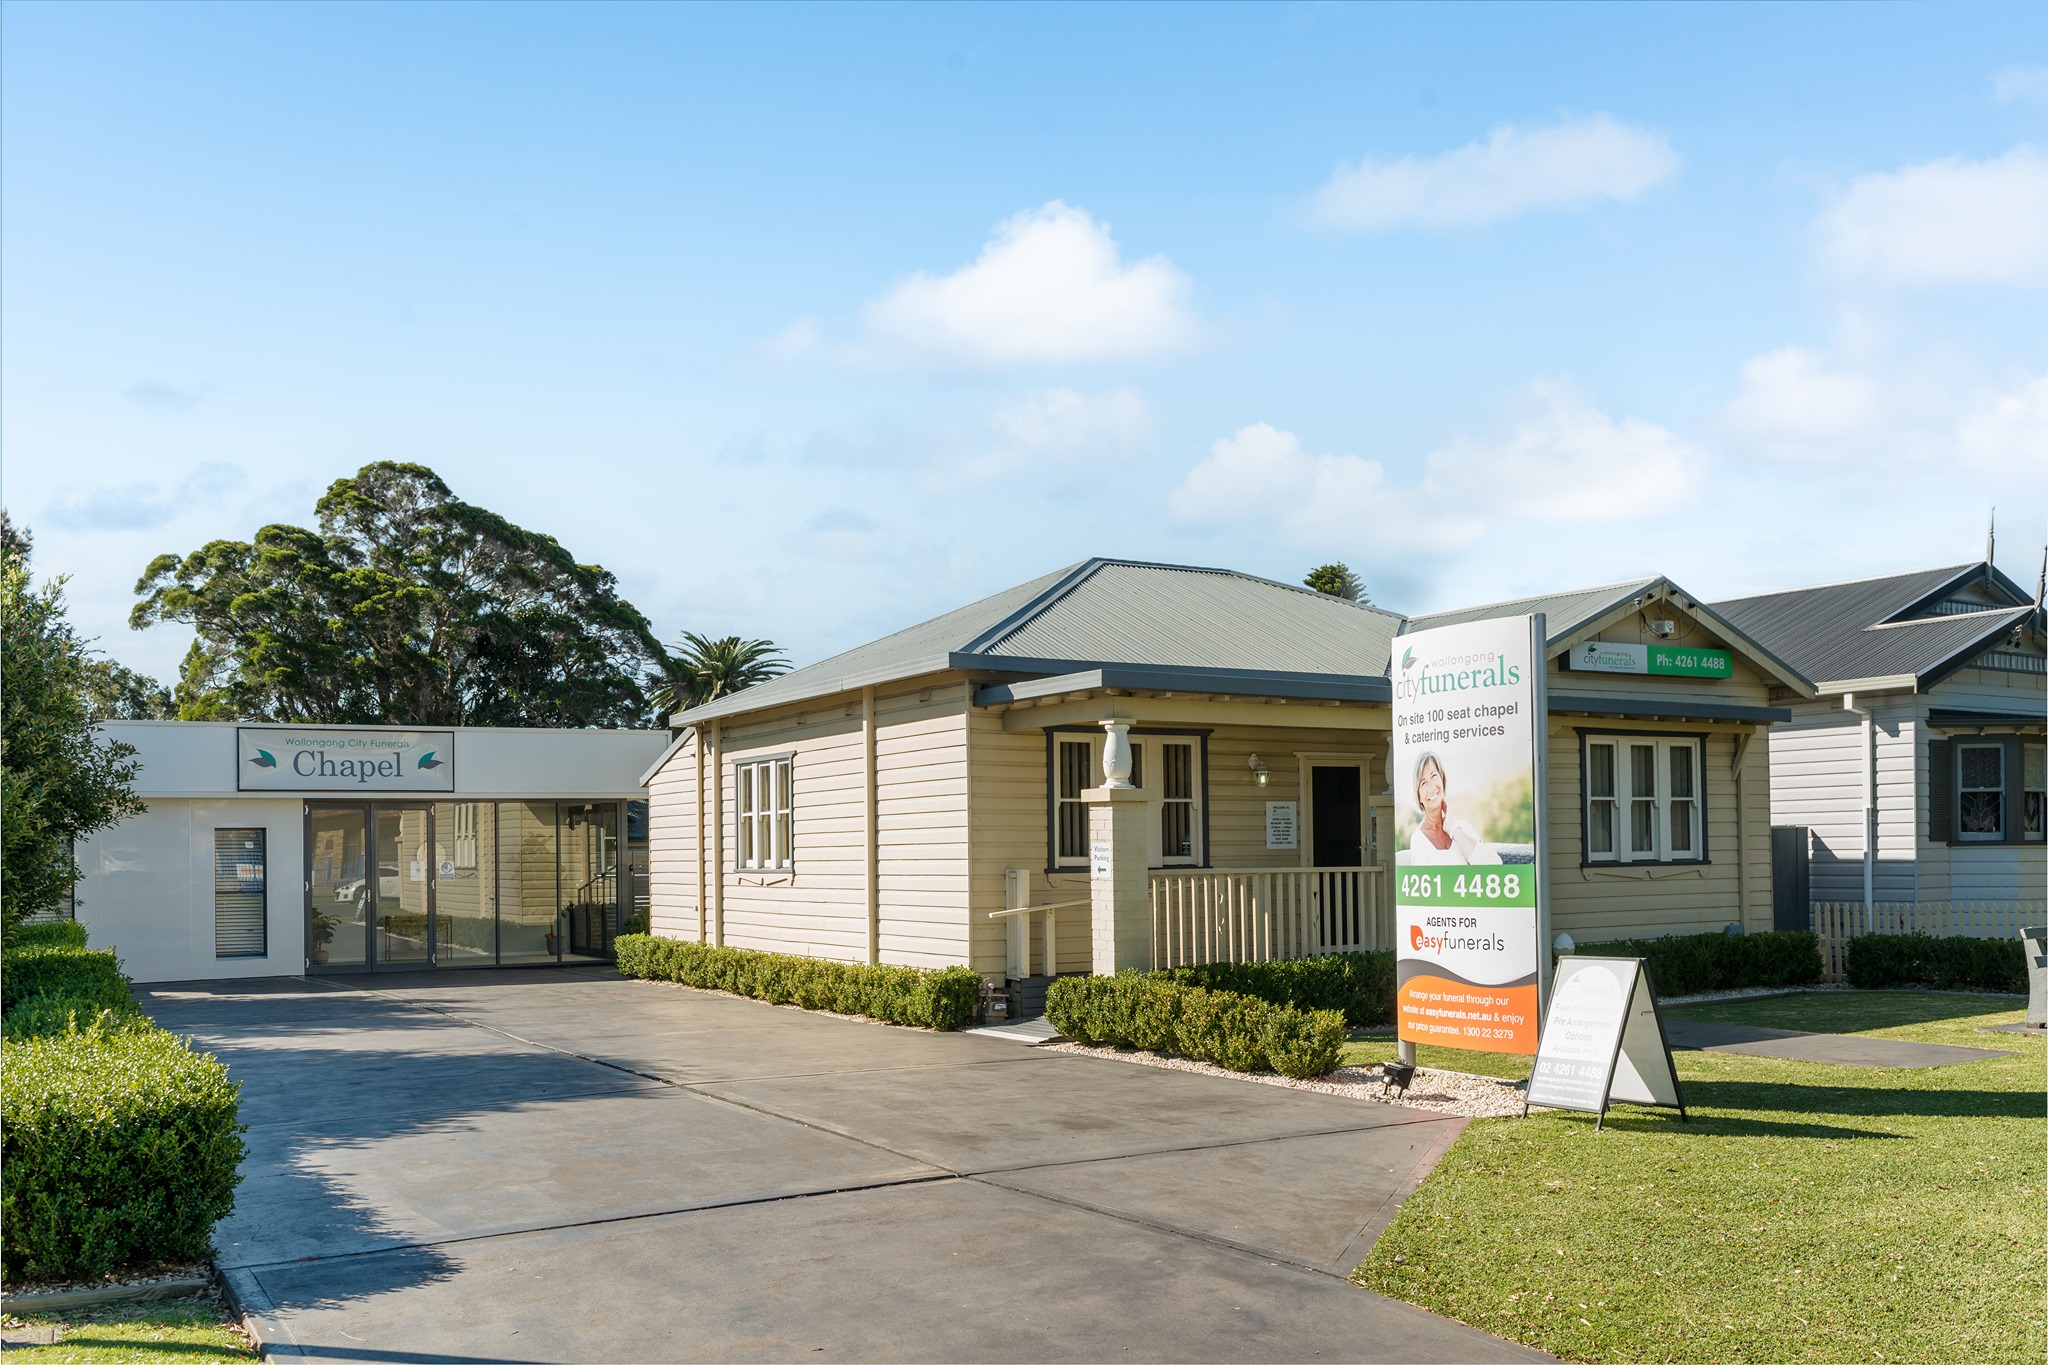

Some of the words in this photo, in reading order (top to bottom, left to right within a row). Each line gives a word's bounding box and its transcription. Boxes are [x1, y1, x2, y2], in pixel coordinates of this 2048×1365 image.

[1430, 652, 1495, 668] wollongong
[1583, 652, 1636, 668] cityfunerals
[1656, 653, 1672, 667] Ph:
[1675, 655, 1697, 668] 4261
[1701, 656, 1725, 670] 4488
[1396, 654, 1520, 705] cityfunerals
[1397, 714, 1408, 727] On
[1409, 712, 1425, 725] site
[1427, 709, 1444, 723] 100
[1447, 706, 1471, 721] seat
[1474, 701, 1519, 719] chapel
[285, 737, 345, 749] Wollongong
[348, 738, 367, 749] City
[370, 739, 410, 748] Funerals
[1404, 732, 1411, 745] &
[1412, 728, 1450, 744] catering
[1452, 724, 1505, 739] services
[292, 750, 404, 783] Chapel
[1093, 845, 1110, 853] Visitors
[1093, 854, 1110, 863] Parking
[1401, 874, 1442, 898] 4261
[1453, 873, 1520, 899] 4488
[1426, 916, 1457, 928] AGENTS
[1459, 917, 1477, 928] FOR
[1415, 931, 1505, 955] easyfunerals
[1409, 988, 1429, 1002] Arrange
[1429, 992, 1441, 1003] your
[1442, 992, 1465, 1003] funeral
[1466, 994, 1494, 1007] through
[1495, 998, 1510, 1006] our
[1402, 1004, 1419, 1015] website
[1419, 1006, 1425, 1015] at
[1425, 1007, 1492, 1021] easyfunerals.net.au
[1494, 1012, 1500, 1022] &
[1502, 1012, 1525, 1025] enjoy
[1553, 1016, 1566, 1026] Pre
[1566, 1017, 1613, 1029] Arrangement
[1407, 1021, 1416, 1029] our
[1416, 1021, 1428, 1032] price
[1429, 1023, 1461, 1035] guarantee.
[1462, 1026, 1480, 1037] 1300
[1481, 1027, 1492, 1038] 22
[1493, 1029, 1514, 1040] 3279
[1565, 1030, 1593, 1042] Options
[1539, 1061, 1552, 1074] 02
[1553, 1063, 1577, 1076] 4261
[1578, 1065, 1603, 1080] 4488
